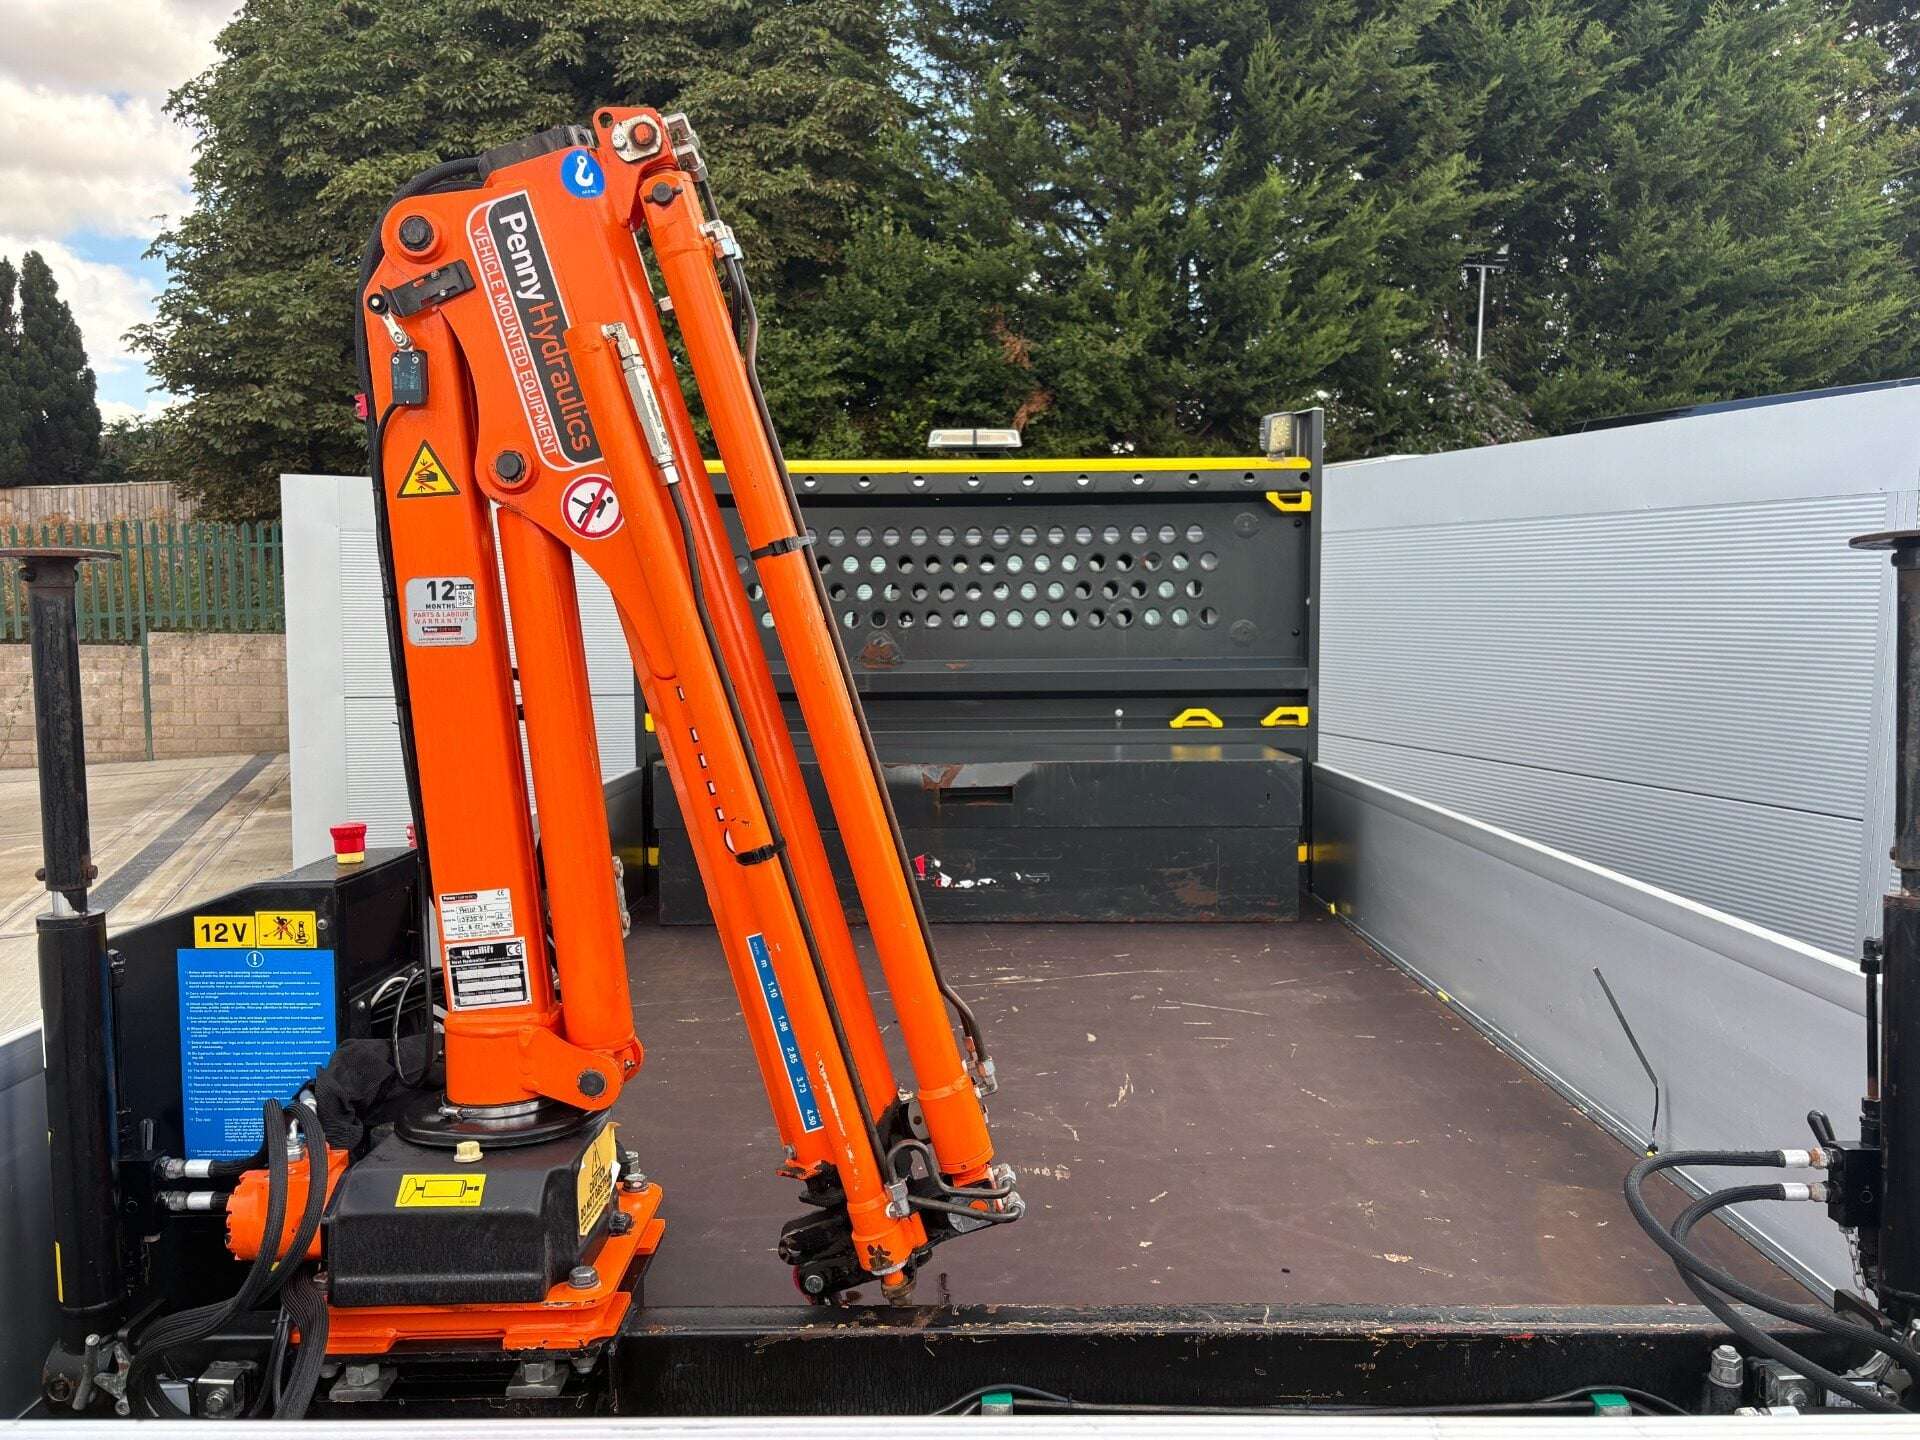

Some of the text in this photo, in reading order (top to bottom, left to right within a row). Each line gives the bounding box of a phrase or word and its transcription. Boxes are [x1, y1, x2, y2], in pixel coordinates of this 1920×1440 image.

[499, 211, 591, 452] Penny Hydraulics
[474, 226, 559, 456] VEHICLE MOUNTED EQUIPMENT
[426, 580, 456, 601] 12
[760, 959, 768, 968] m
[767, 981, 778, 998] 1.10
[786, 1046, 798, 1064] 2.85
[796, 1076, 807, 1094] 3.73
[805, 1109, 817, 1126] 4.50
